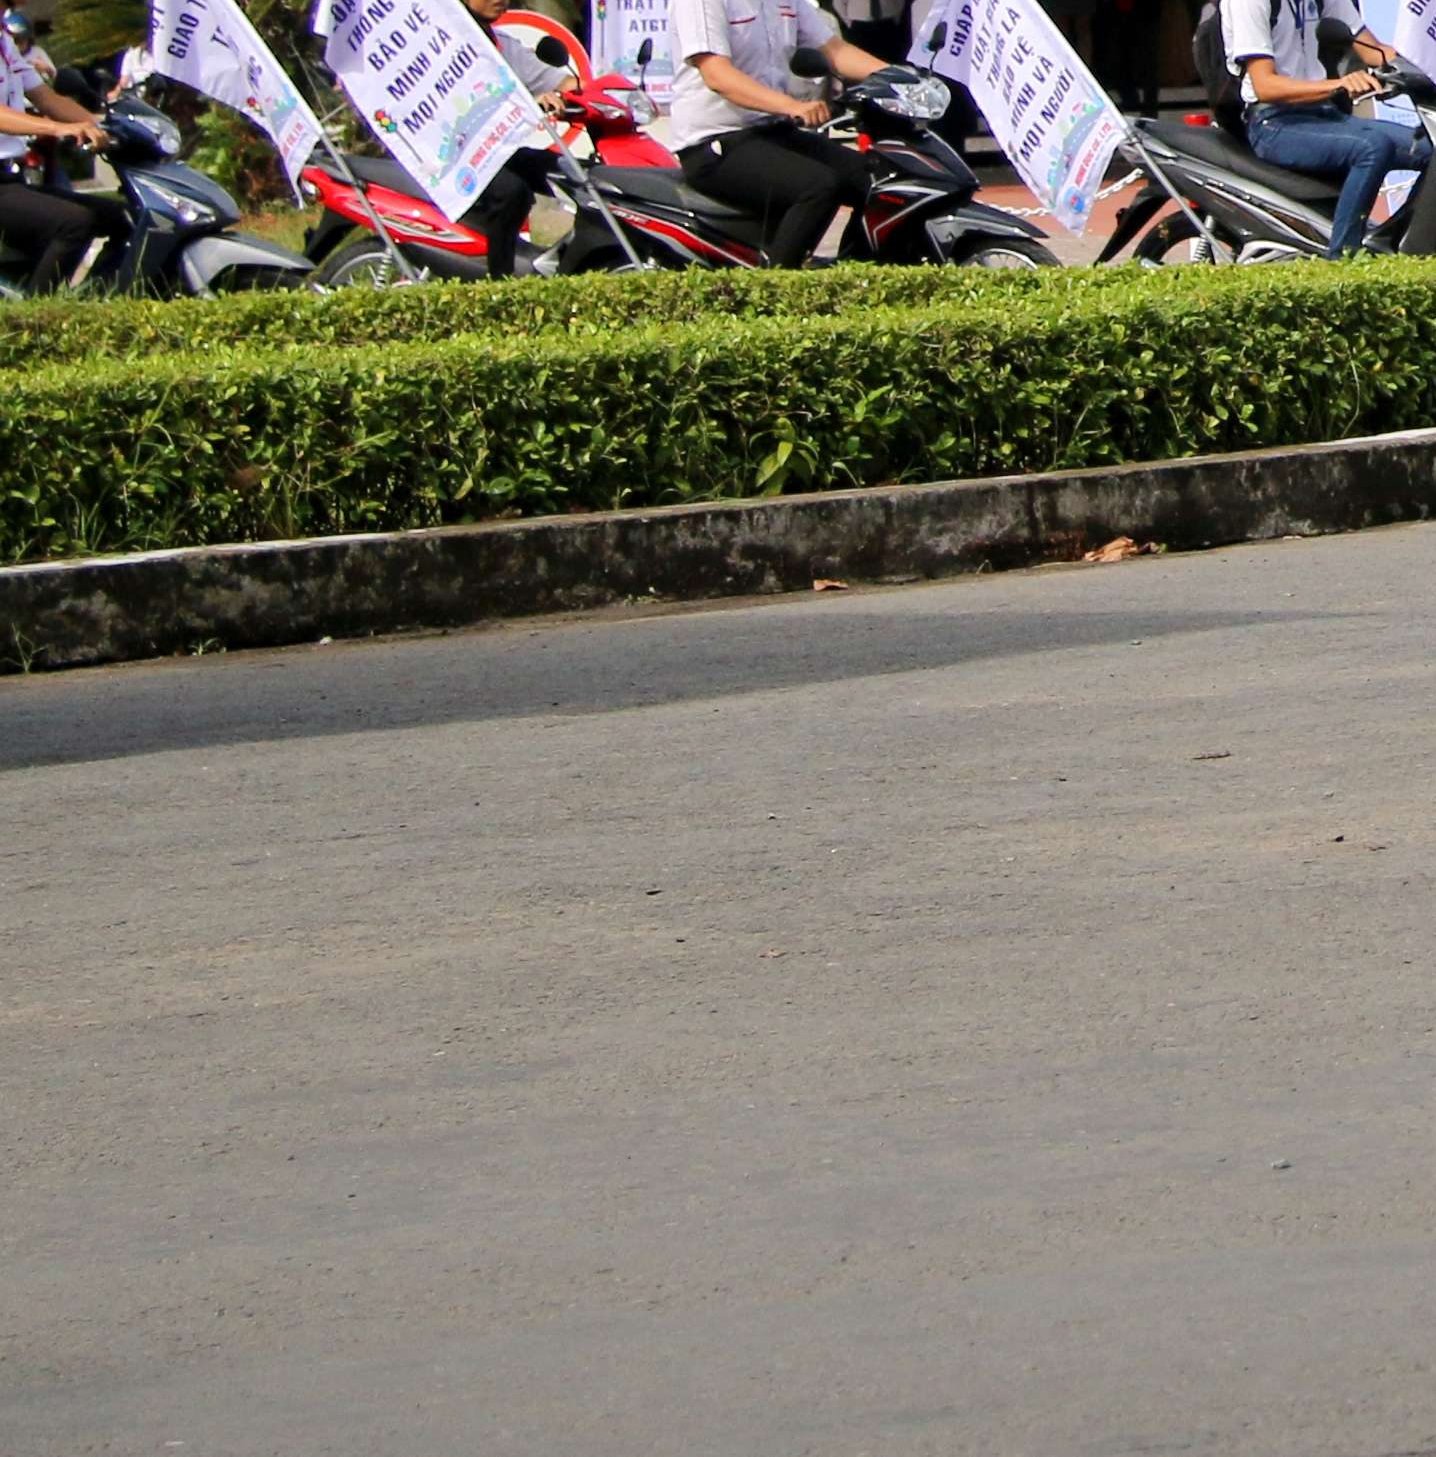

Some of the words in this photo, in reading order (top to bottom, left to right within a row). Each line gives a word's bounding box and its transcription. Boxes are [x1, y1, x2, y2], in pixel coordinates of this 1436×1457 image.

[167, 13, 200, 59] GIAO
[629, 19, 668, 33] ATGT
[368, 30, 407, 72] BẢO
[386, 51, 431, 102] MÌNH
[428, 25, 452, 56] VÀ
[1031, 54, 1054, 84] VÀ
[403, 93, 438, 135] MỌI
[434, 43, 479, 99] NGƯỜI
[1020, 122, 1046, 163] MỌI
